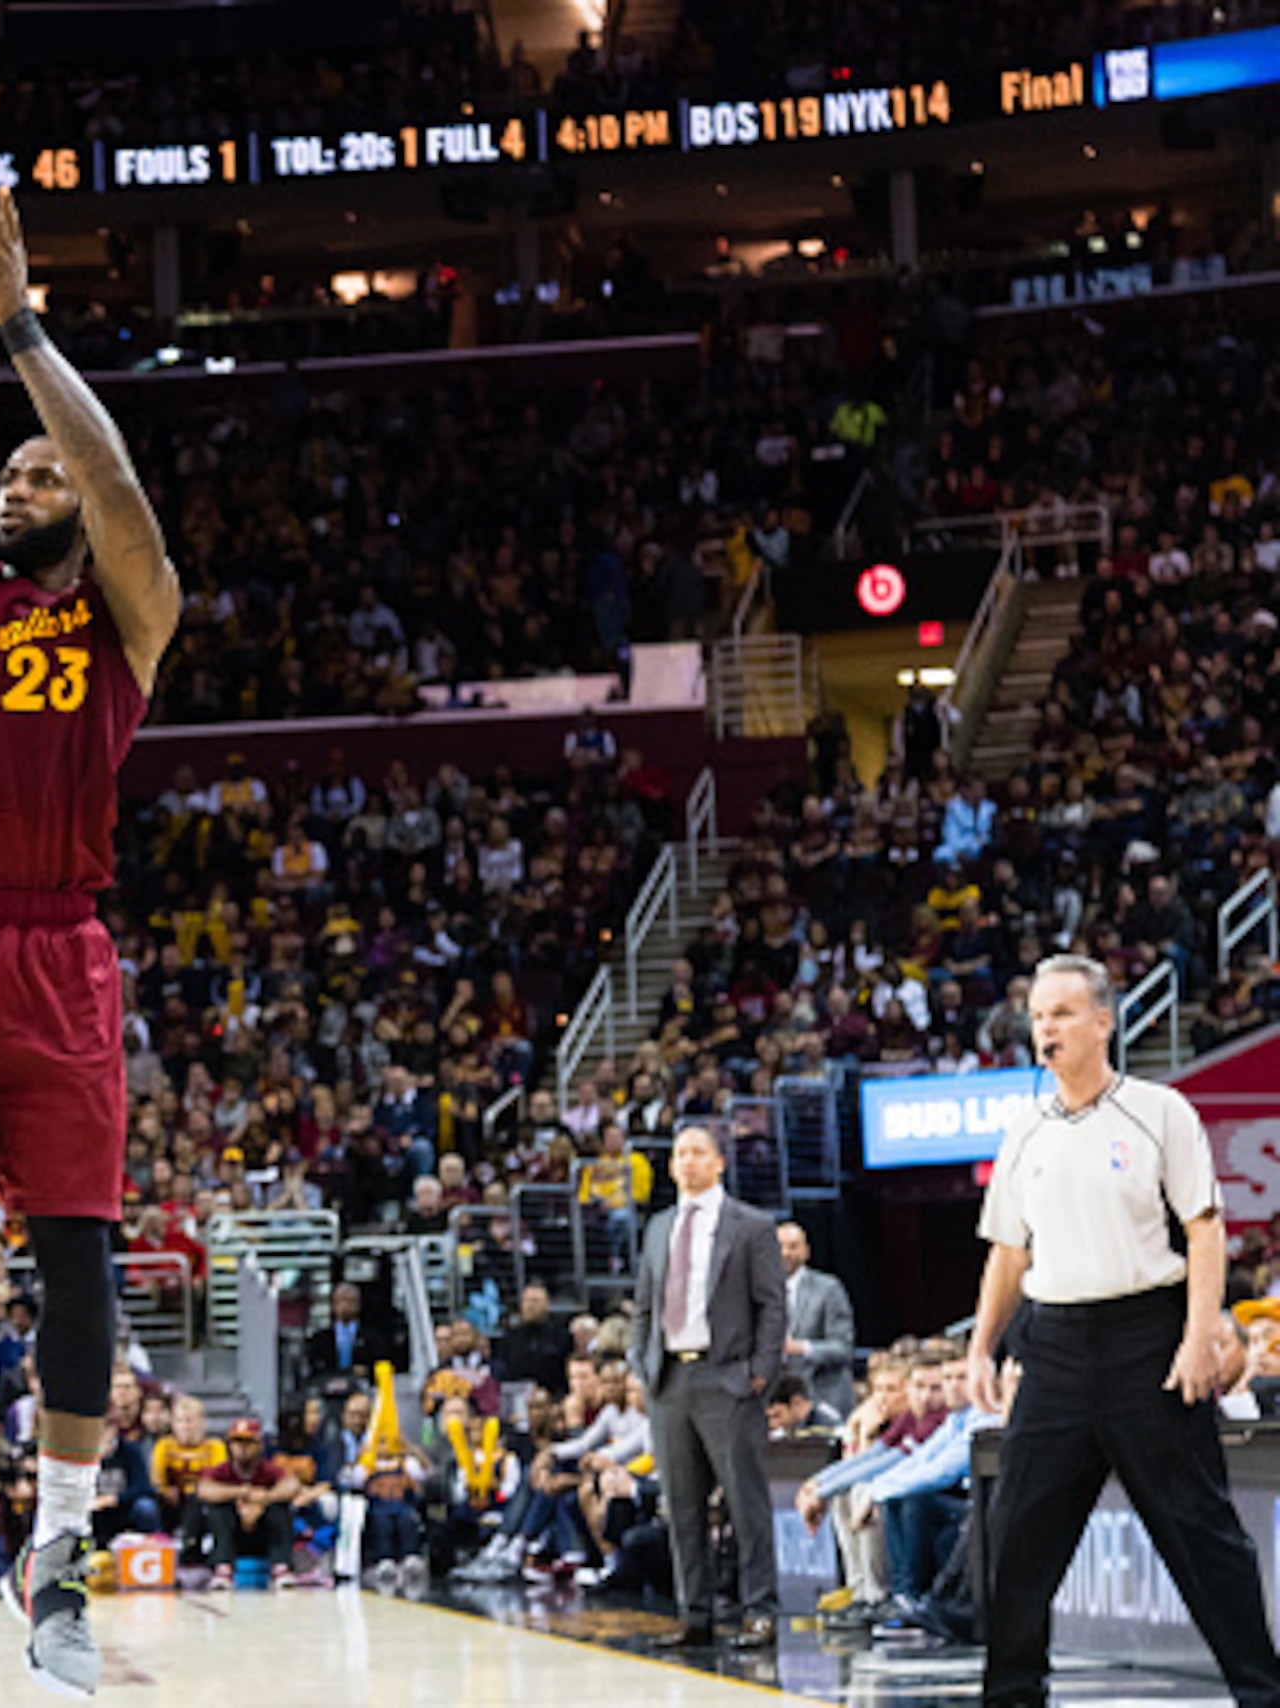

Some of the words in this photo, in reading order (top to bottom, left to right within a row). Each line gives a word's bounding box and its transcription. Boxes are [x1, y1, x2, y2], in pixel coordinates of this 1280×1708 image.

[1001, 64, 1083, 113] Final
[557, 115, 621, 151] 4:10
[625, 110, 668, 145] PM
[690, 102, 759, 146] BOS
[761, 97, 820, 140] 119
[824, 91, 891, 135] NYK
[890, 84, 949, 127] 114
[115, 145, 211, 184] FOULS
[220, 141, 236, 182] 1
[272, 138, 337, 175] TOL:
[340, 132, 395, 170] 20s
[401, 127, 417, 167] 1
[426, 122, 499, 163] FULL
[501, 119, 525, 158] 4
[33, 149, 80, 189] 46
[0, 645, 91, 711] 23
[885, 1100, 961, 1140] BUD
[129, 1551, 162, 1585] G
